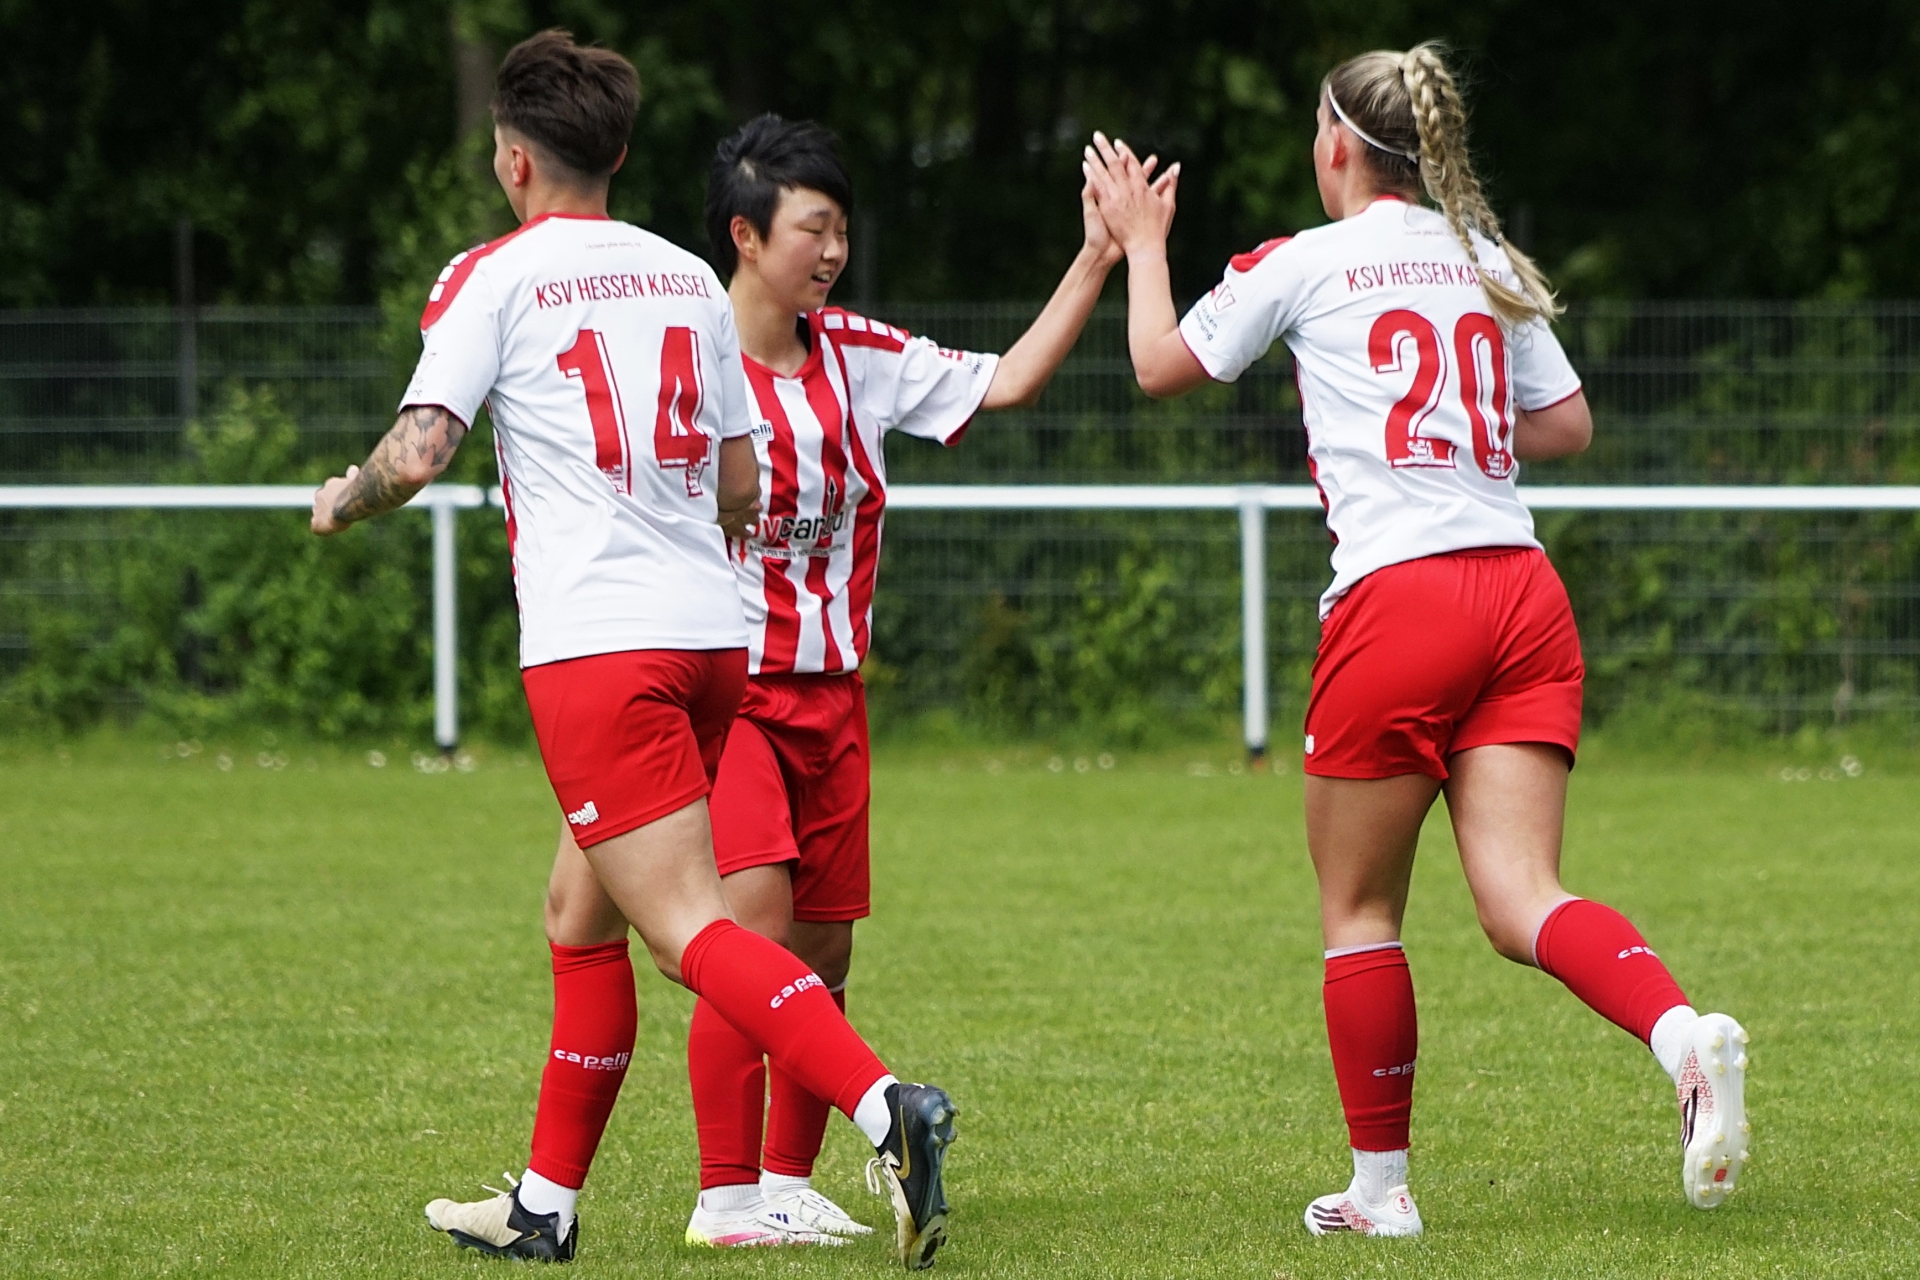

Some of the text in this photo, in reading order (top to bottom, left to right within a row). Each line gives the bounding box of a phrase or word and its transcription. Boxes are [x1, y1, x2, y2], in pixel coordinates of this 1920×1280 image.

[535, 273, 711, 309] KSV HESSEN KASSEL
[1346, 262, 1502, 292] KSV HESSEN KAE
[1367, 309, 1515, 480] 20
[556, 326, 712, 497] 14
[751, 423, 773, 436] elli
[553, 1049, 630, 1069] capelli
